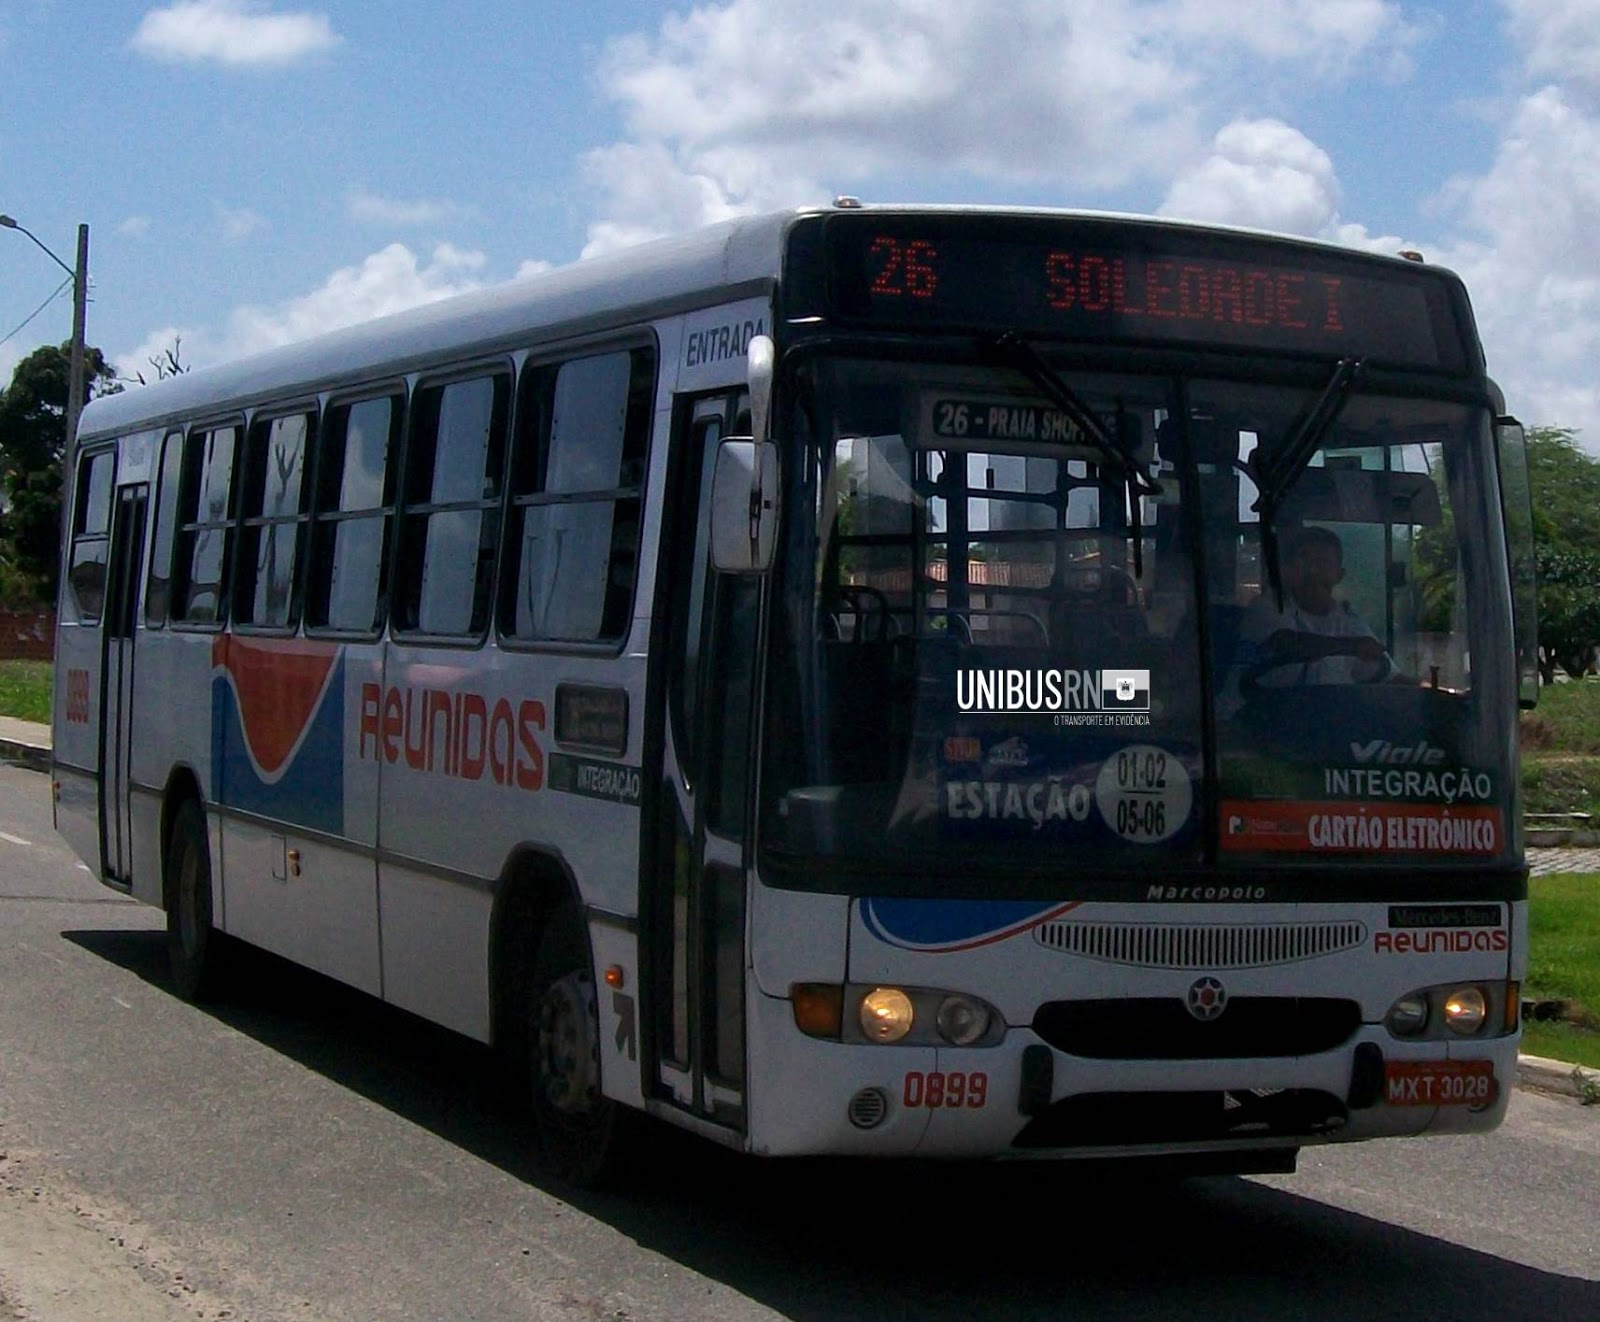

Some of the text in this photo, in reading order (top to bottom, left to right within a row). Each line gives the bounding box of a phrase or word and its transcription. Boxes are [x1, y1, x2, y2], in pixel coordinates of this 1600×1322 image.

[871, 235, 937, 298] 26
[1047, 253, 1306, 328] SOLEDADE
[939, 403, 969, 435] 26
[988, 406, 1036, 440] PRAIA
[1350, 740, 1445, 765] Viale
[577, 764, 640, 802] INTEGRAÇÃO
[1325, 767, 1492, 804] INTEGRAÇÃO
[946, 776, 1091, 829] ESTAÇÃO
[1308, 807, 1382, 850] CARTÃO
[1386, 809, 1496, 851] ELETRÔNICO
[1147, 884, 1266, 900] Marcopolo
[904, 1072, 988, 1108] 0899
[1388, 1075, 1489, 1101] MXT 3028
